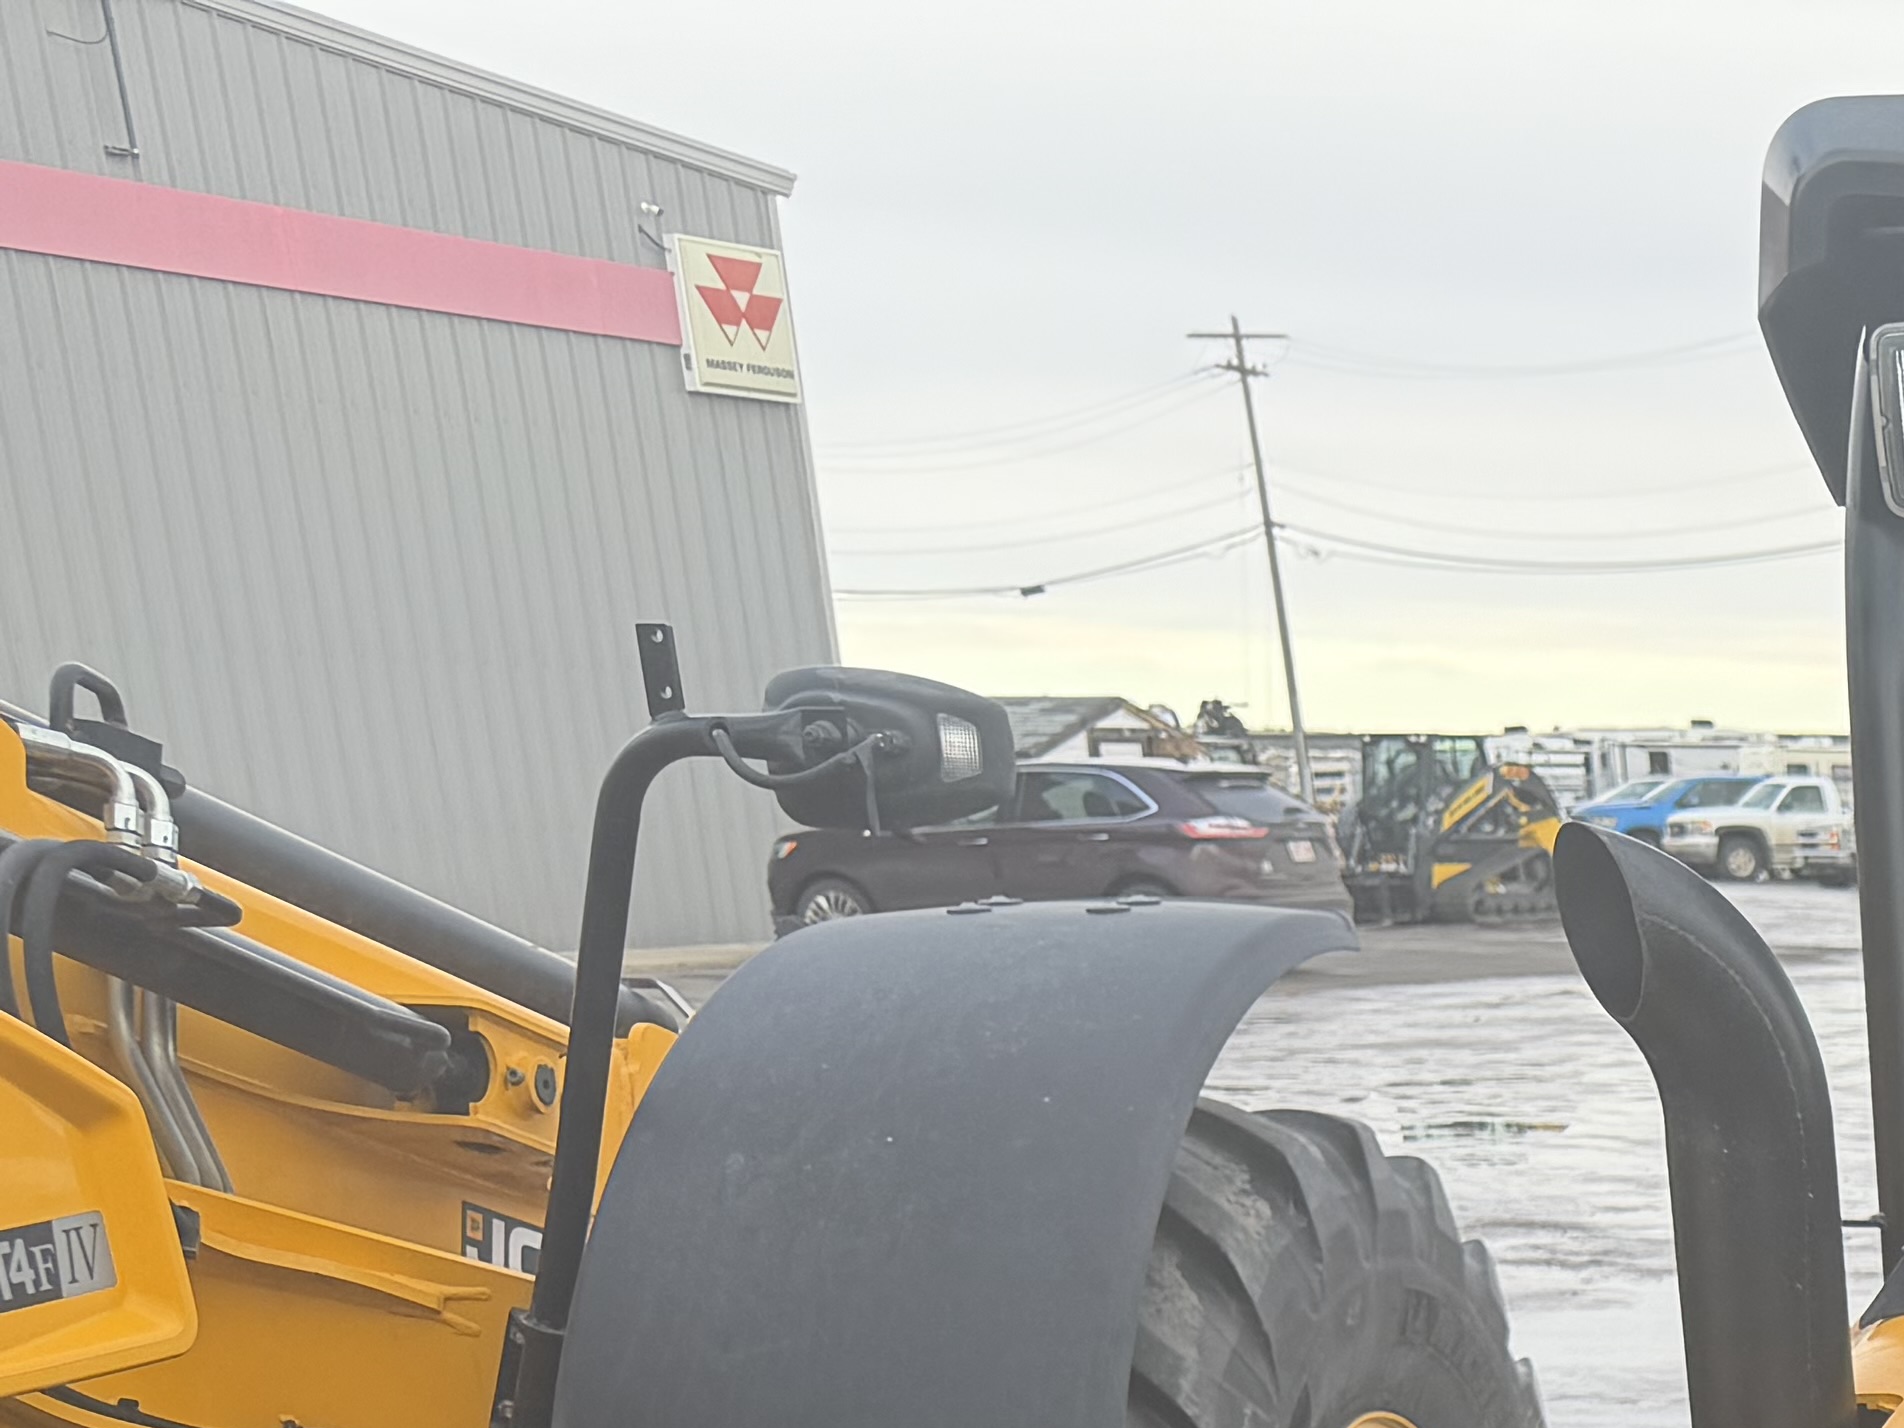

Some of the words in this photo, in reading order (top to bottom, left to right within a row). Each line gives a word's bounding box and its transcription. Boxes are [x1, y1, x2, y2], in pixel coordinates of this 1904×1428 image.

[706, 358, 744, 373] MASSEY
[746, 363, 796, 379] FERGUSON
[62, 1223, 99, 1284] IV
[466, 1218, 543, 1272] JC
